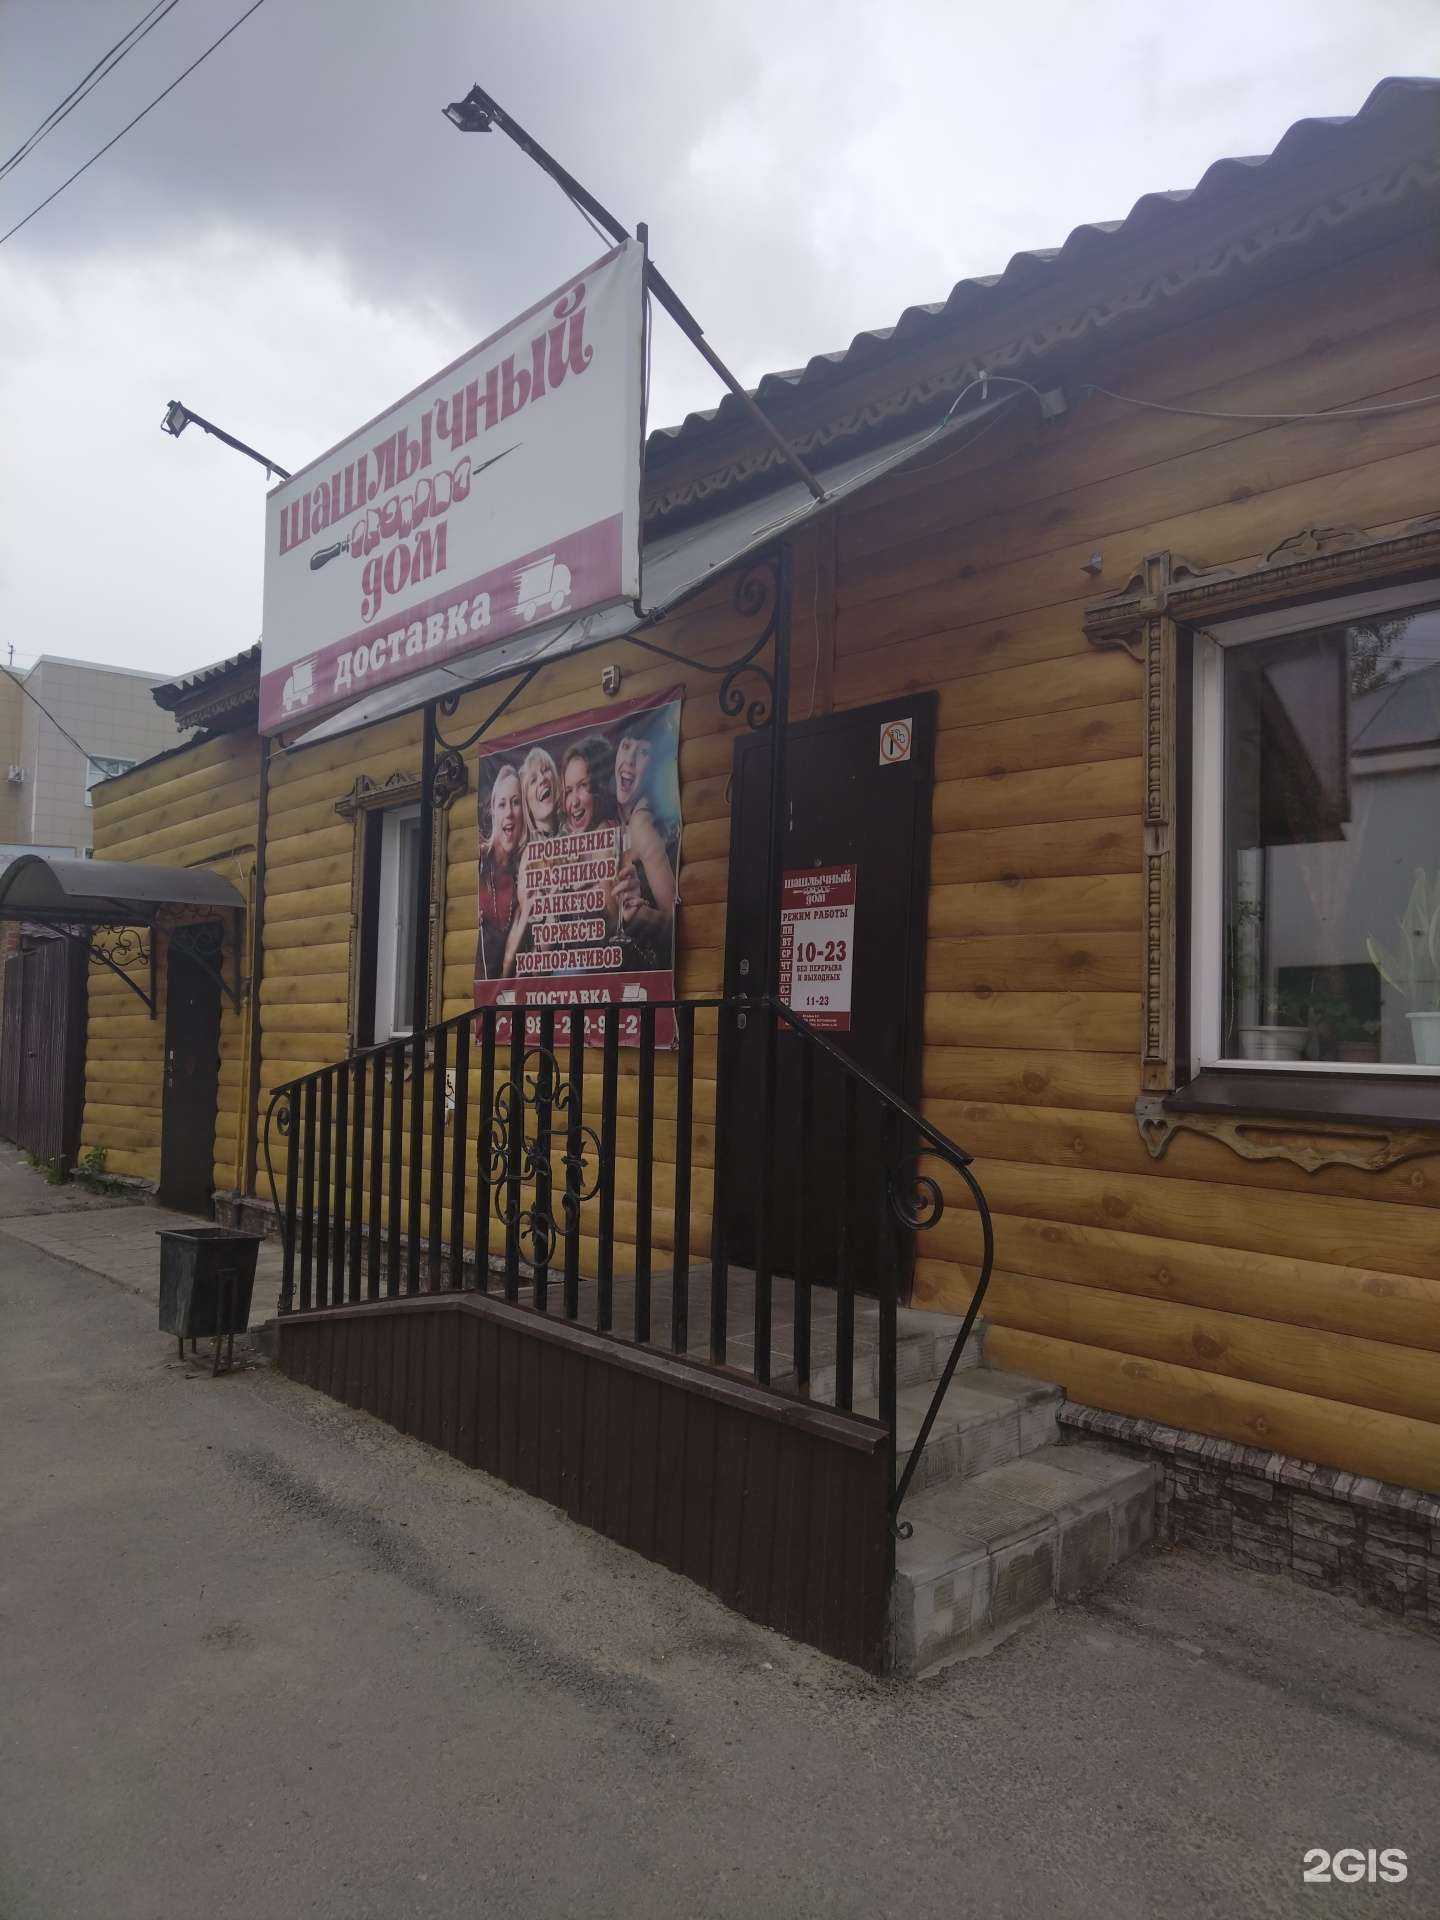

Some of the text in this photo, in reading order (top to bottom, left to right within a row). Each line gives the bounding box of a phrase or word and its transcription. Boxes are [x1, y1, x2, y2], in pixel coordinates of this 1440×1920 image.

[527, 830, 616, 861] ПРОВЕДЕНИЕ
[526, 860, 616, 889] ПРАЗДНИКОВ
[533, 890, 605, 915] БАНКЕТОВ
[783, 908, 848, 921] РЕЖИМ РАБОТЫ
[532, 920, 605, 943] ТОРЖЕСТВ
[782, 926, 793, 934] ПН
[781, 949, 791, 957] СР
[782, 938, 792, 946] ВТ
[797, 940, 846, 962] 10-23
[516, 947, 622, 972] КОРПОРАТИВОВ
[806, 995, 829, 1005] 11-23
